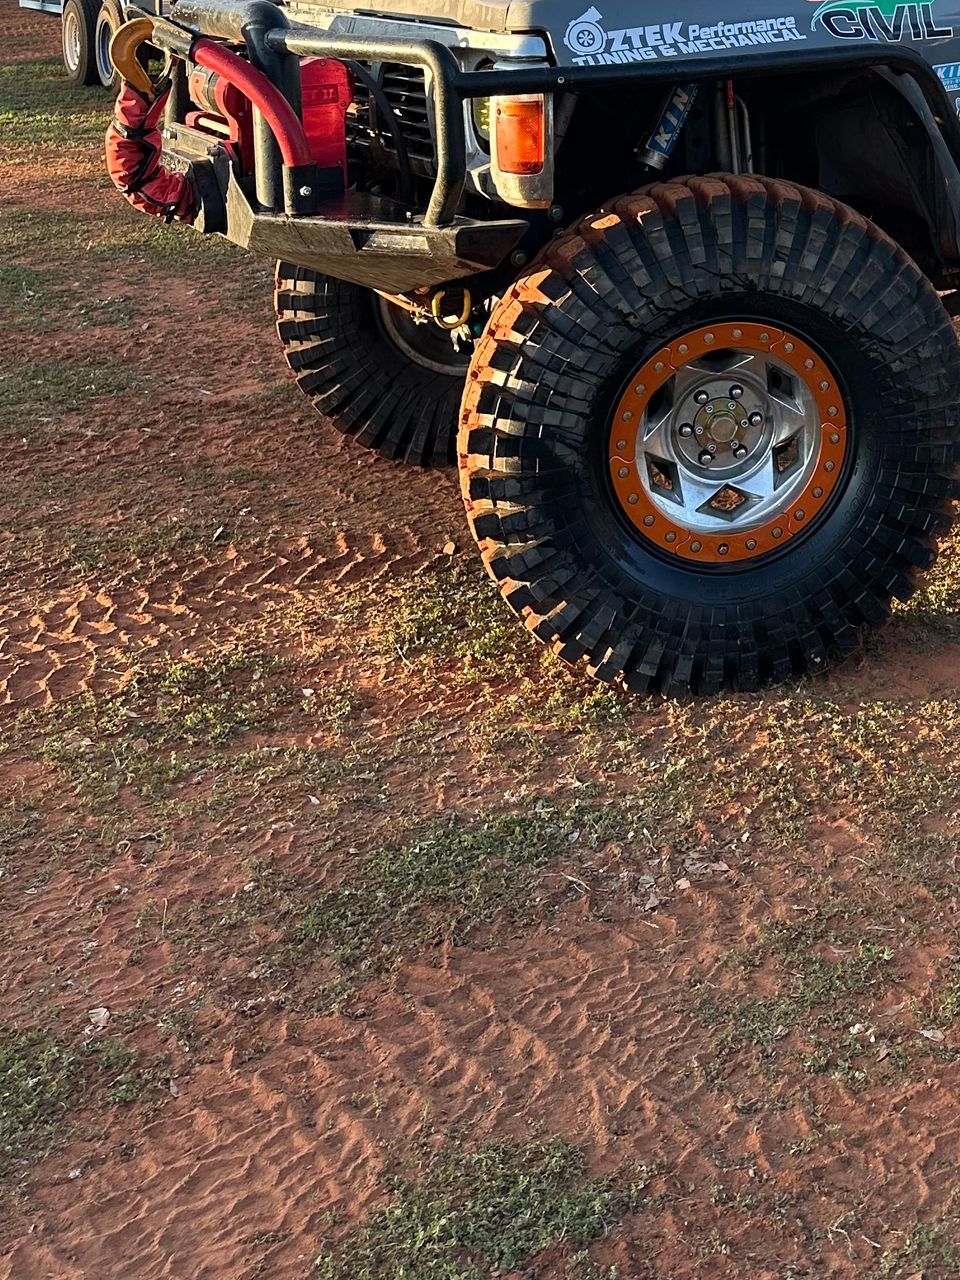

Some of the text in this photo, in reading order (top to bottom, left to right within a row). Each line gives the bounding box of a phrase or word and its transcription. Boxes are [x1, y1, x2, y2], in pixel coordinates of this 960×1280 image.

[688, 15, 796, 40] Performance
[820, 2, 953, 42] CIVIL
[572, 28, 807, 66] TUNING & MECHANICAL
